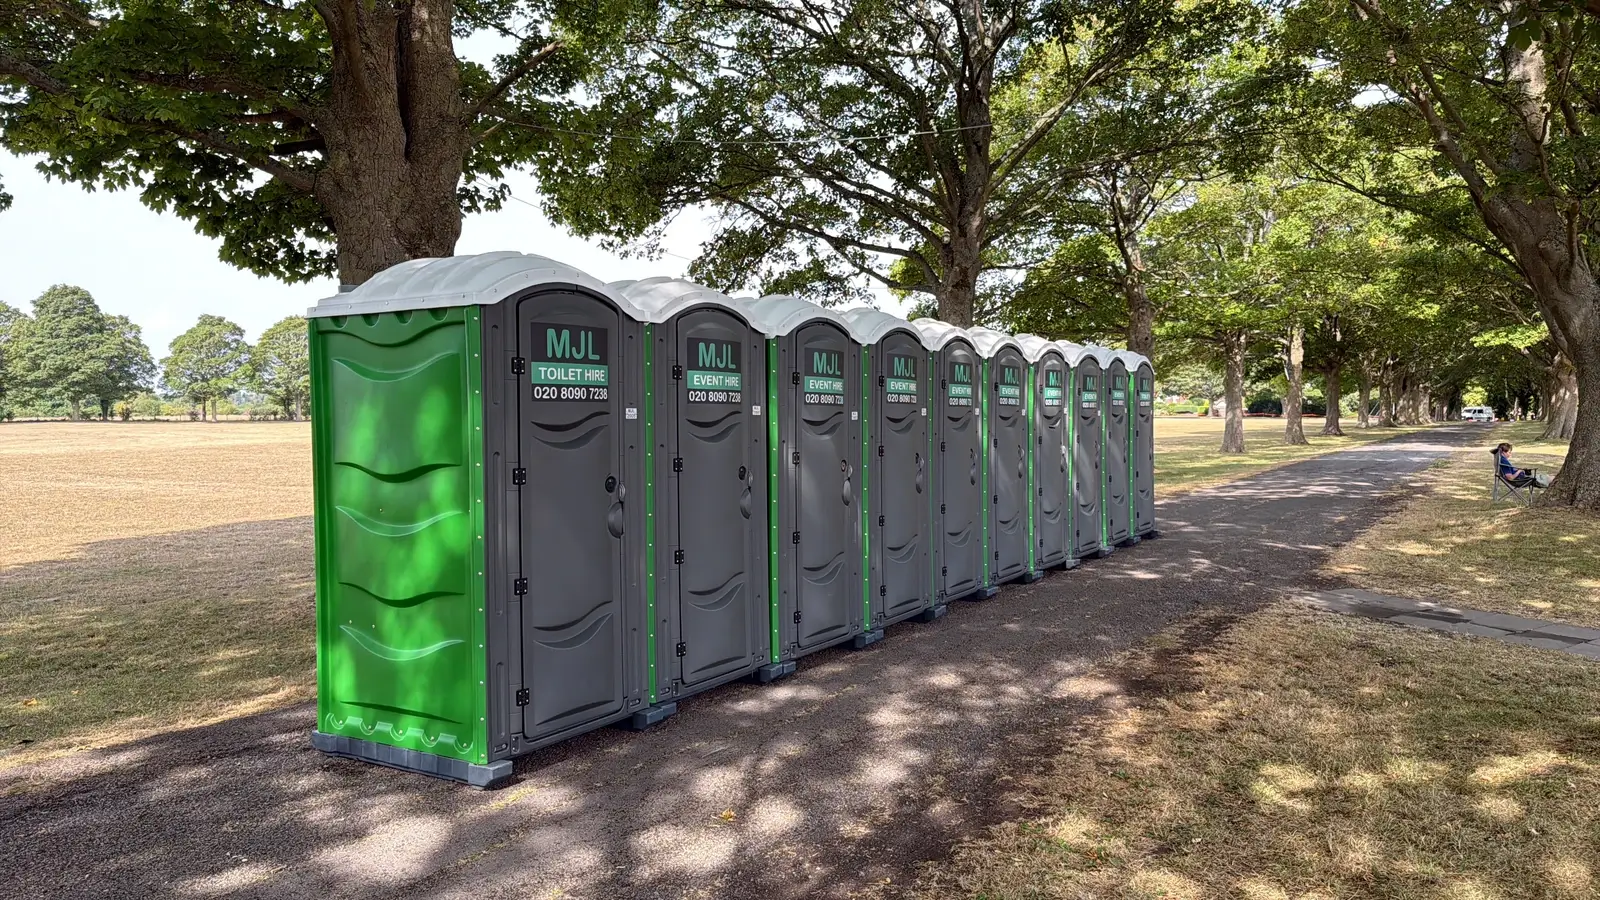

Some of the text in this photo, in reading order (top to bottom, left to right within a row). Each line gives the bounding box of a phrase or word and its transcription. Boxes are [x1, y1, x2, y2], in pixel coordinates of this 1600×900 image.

[546, 328, 600, 360] MJL
[698, 342, 736, 369] MJL
[813, 351, 841, 375] MJL
[893, 357, 915, 377] MJL
[538, 367, 605, 382] TOILET HIRE
[693, 374, 739, 387] EVENT HIRE
[809, 379, 843, 391] EVENT HIRE
[890, 381, 909, 391] EVENT
[534, 386, 608, 400] 020 8090 7238
[688, 391, 741, 403] 020 8090 7238
[805, 394, 820, 403] 020
[820, 394, 835, 404] 8090
[887, 394, 898, 403] 020
